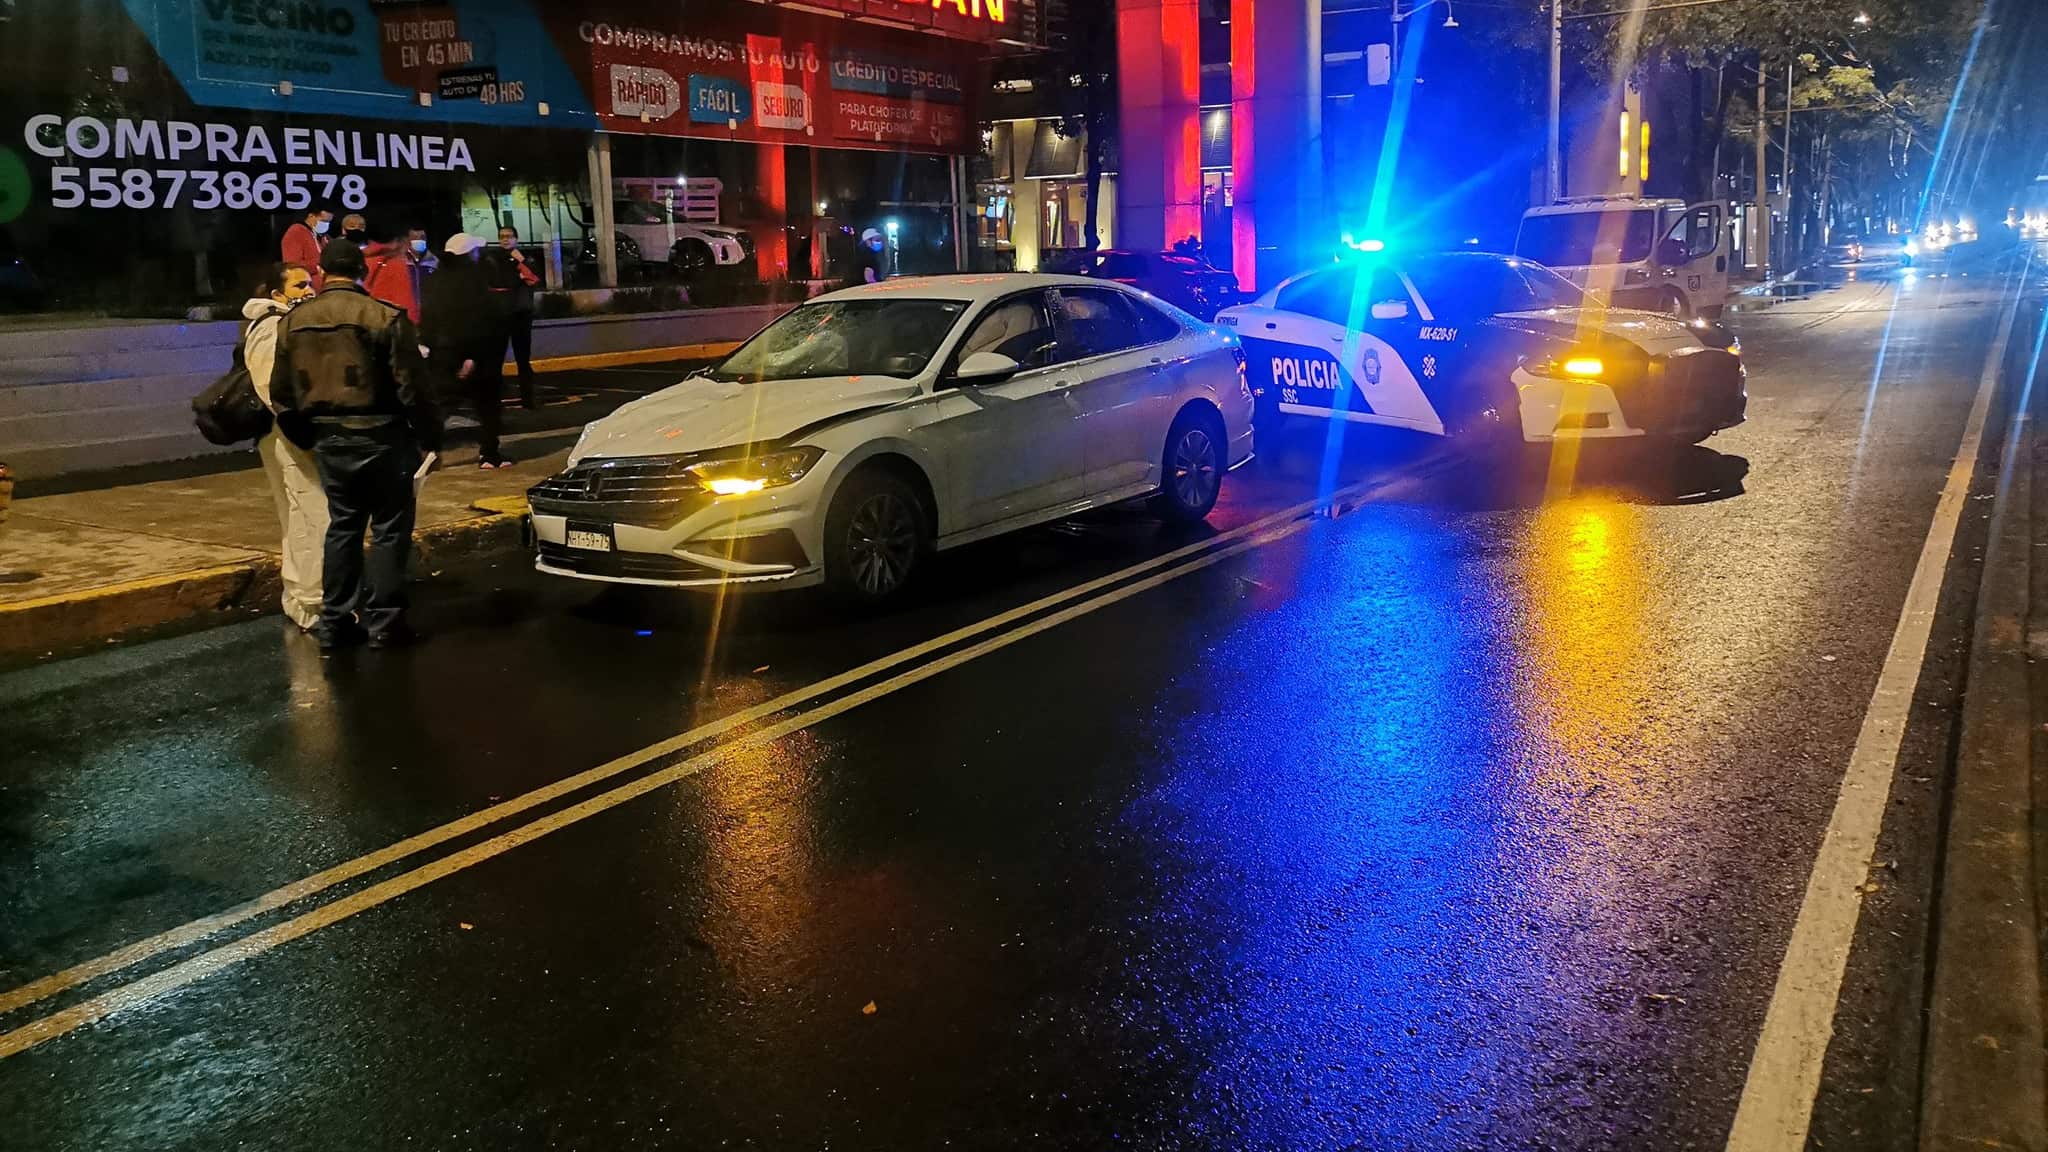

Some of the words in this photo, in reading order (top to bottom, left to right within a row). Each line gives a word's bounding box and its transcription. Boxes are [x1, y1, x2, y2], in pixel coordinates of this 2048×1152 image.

[384, 23, 400, 42] TU
[578, 22, 735, 62] COMPRAMOS
[401, 46, 420, 68] EN
[426, 43, 445, 65] 45
[448, 41, 473, 63] MIN
[902, 69, 961, 92] ESPECIAL
[480, 83, 497, 104] 48
[499, 81, 526, 103] HRS
[763, 95, 805, 118] SEGURO
[839, 102, 868, 116] PARA
[868, 104, 908, 120] CHOFER
[24, 114, 278, 164] COMPRA
[283, 127, 348, 166] EN
[352, 131, 476, 173] LINEA
[51, 166, 368, 210] 5587386578
[1271, 356, 1344, 390] POLICIA
[1282, 387, 1299, 404] SSC
